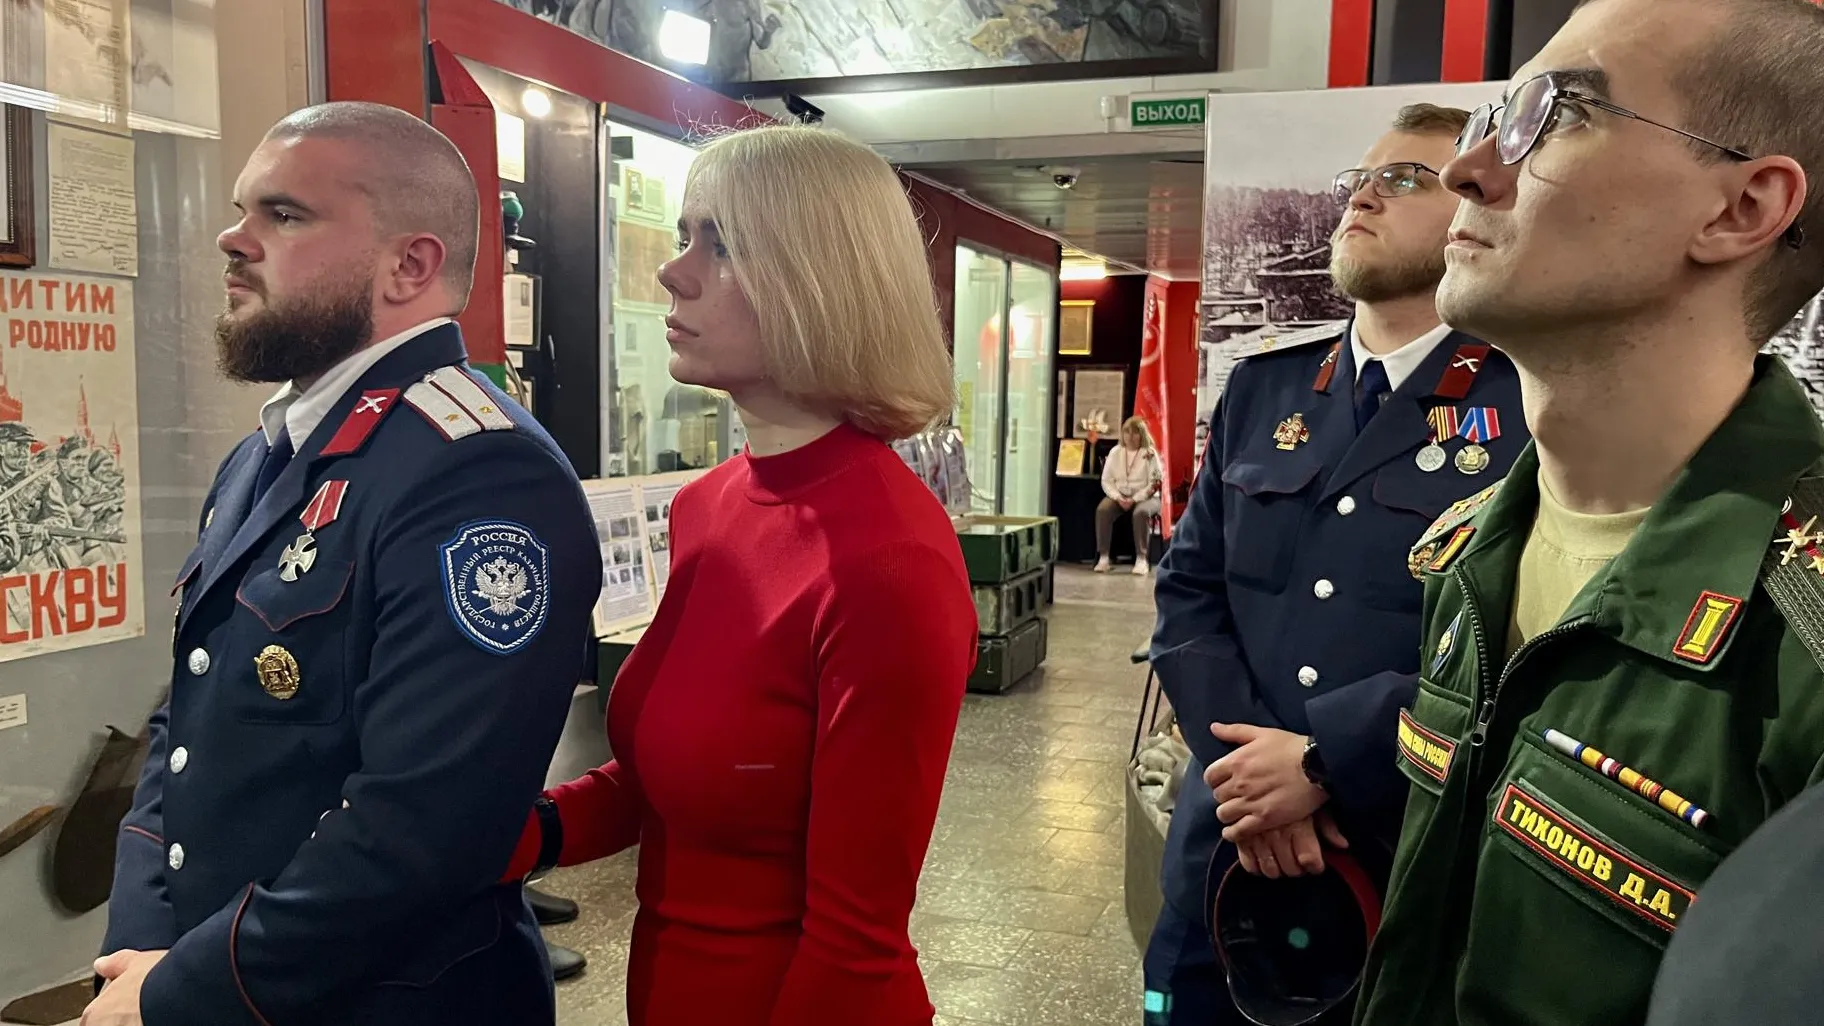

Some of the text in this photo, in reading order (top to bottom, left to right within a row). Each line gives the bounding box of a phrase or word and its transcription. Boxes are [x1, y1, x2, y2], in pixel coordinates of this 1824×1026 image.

[1136, 104, 1202, 122] ВЫХОД
[0, 277, 115, 314] ИТИМ
[8, 318, 117, 352] РОДНУЮ
[471, 532, 528, 547] РОССИЯ
[481, 545, 516, 556] РЕЕСТР
[1509, 799, 1677, 919] ТИХОНОВ Д.А.
